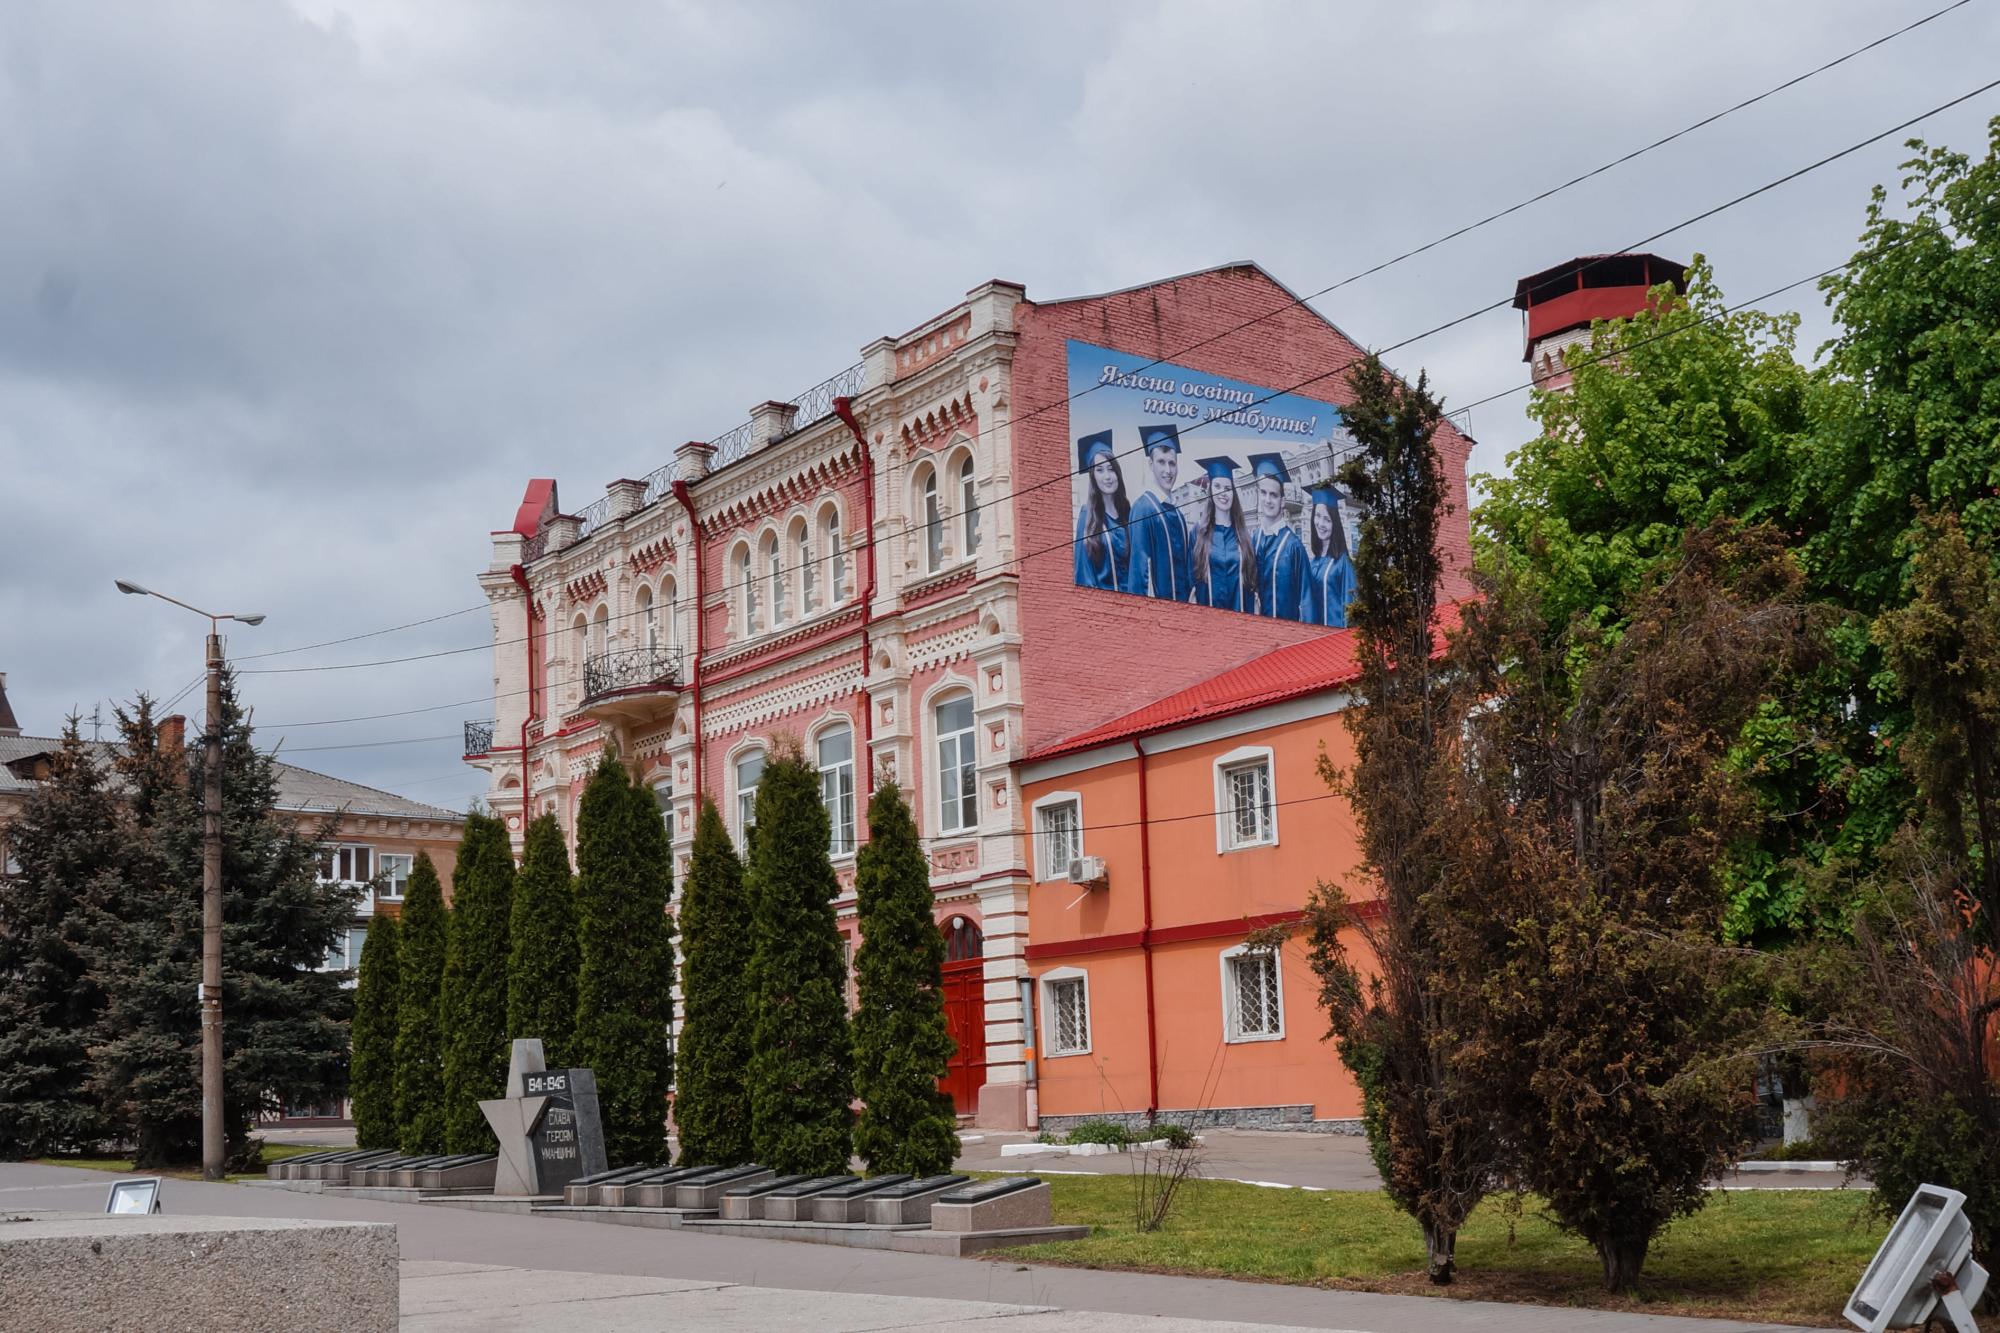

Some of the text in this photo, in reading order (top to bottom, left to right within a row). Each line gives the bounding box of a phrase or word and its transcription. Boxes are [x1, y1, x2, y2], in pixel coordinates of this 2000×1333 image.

[1099, 365, 1175, 393] Якісна
[1181, 382, 1255, 405] освіта
[1143, 397, 1317, 435] твоє майбутнє!
[548, 1112, 571, 1126] СЛАВА
[546, 1130, 574, 1143] ГЕРОЯМ
